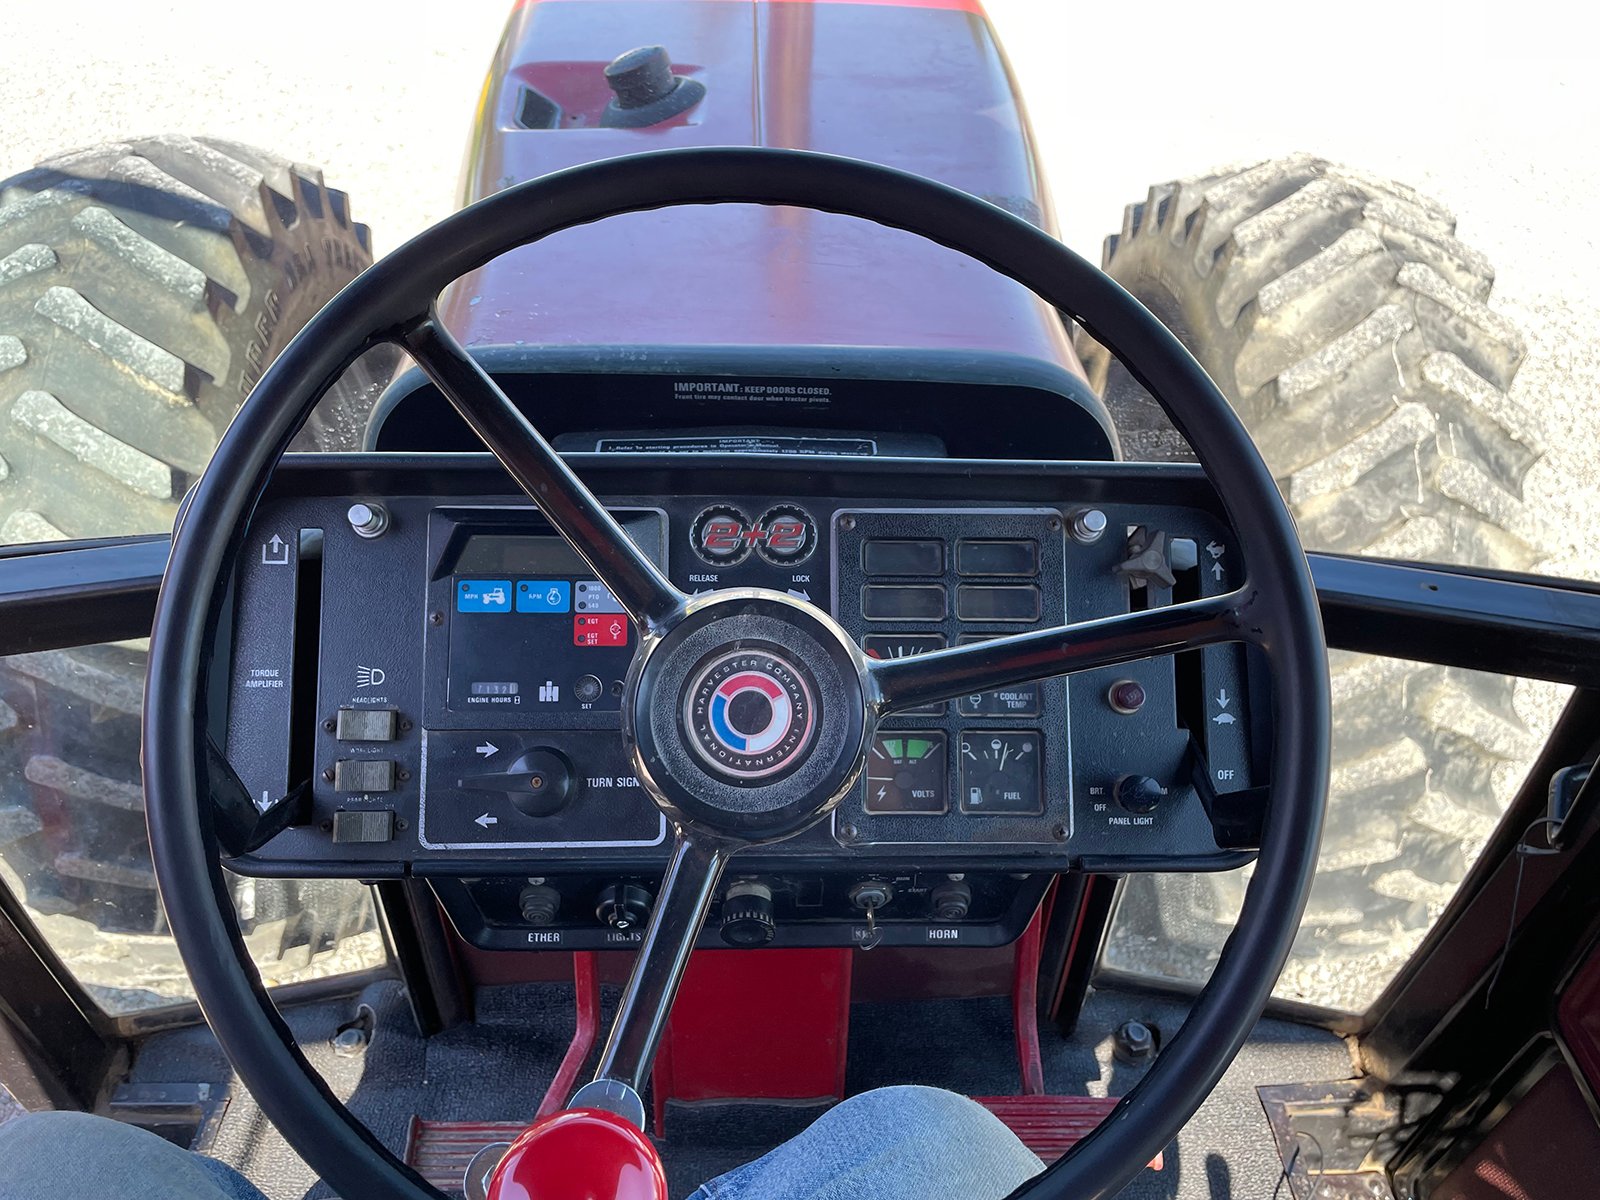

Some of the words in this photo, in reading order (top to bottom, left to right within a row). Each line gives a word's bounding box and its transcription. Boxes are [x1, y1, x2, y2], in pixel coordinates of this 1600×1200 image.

[674, 382, 743, 393] IMPORTANT:
[766, 386, 796, 394] DOORS
[797, 387, 832, 396] CLOSED.
[689, 574, 719, 582] RELEASE
[792, 575, 811, 583] LOCK
[250, 669, 280, 678] TORQUE
[245, 680, 284, 688] AMPLIFIER
[697, 660, 757, 714] HARVESTER
[766, 662, 803, 720] COMPANY
[467, 696, 490, 704] ENGINE
[999, 692, 1034, 701] COOLANT
[1007, 701, 1027, 709] TEMP
[700, 725, 799, 766] INTERNATIONAL
[1217, 769, 1235, 780] OFF
[586, 777, 613, 788] TURN
[911, 790, 935, 798] VOLTS
[1004, 792, 1021, 800] FUEL
[1094, 804, 1107, 812] OFF
[1108, 817, 1131, 825] PANEL
[1133, 817, 1154, 825] LIGHT
[527, 932, 560, 943] ETHER
[929, 929, 958, 939] HORN
